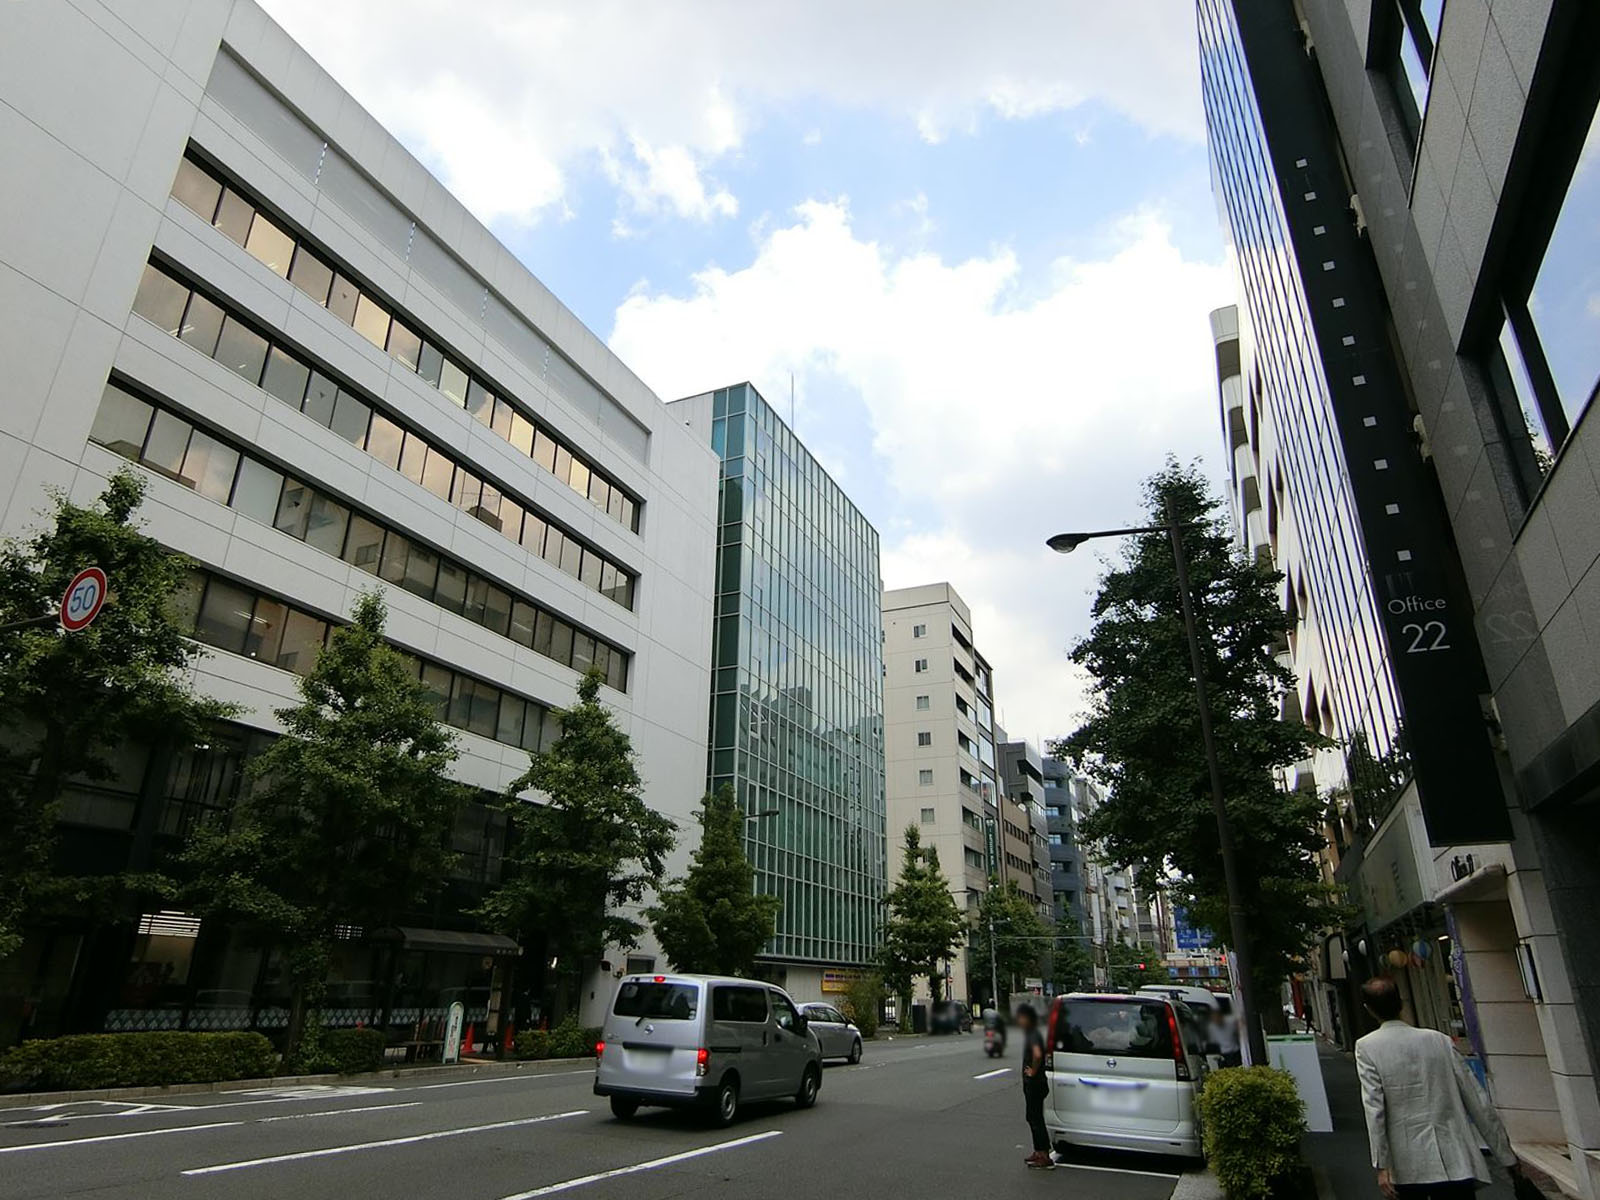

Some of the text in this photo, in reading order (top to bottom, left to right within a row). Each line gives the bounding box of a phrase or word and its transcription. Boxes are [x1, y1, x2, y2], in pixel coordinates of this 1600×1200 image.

[70, 585, 96, 613] 50
[1388, 595, 1446, 614] Office
[1402, 621, 1450, 653] 22
